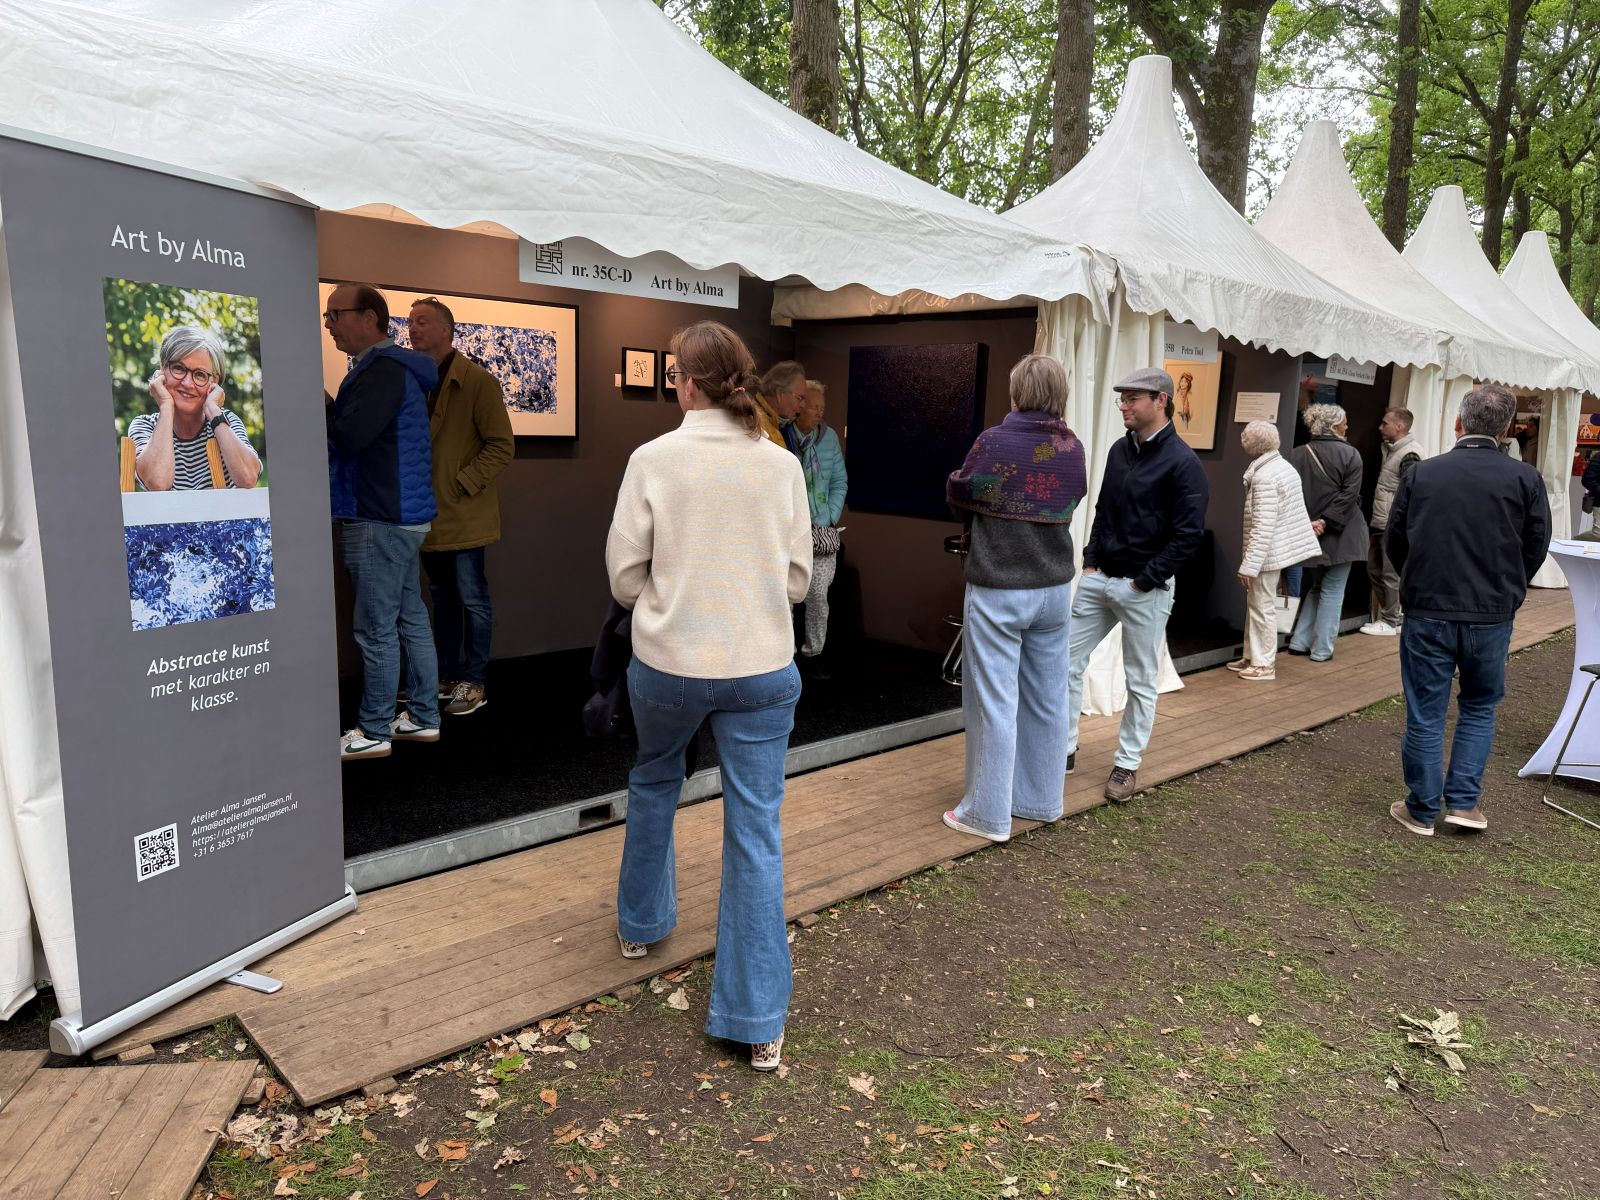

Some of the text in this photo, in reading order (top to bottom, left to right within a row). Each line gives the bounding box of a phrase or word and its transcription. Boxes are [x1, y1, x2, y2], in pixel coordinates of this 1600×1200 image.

[111, 224, 246, 268] Art by Alma
[572, 264, 724, 297] nr. 35C-D Art by Alma
[146, 639, 270, 676] Abstracte kunst
[150, 661, 270, 699] met karakter en
[191, 690, 239, 712] klasse.
[190, 792, 267, 825] Atelier Alma Jansen
[193, 828, 254, 858] +31 6 3653 7617
